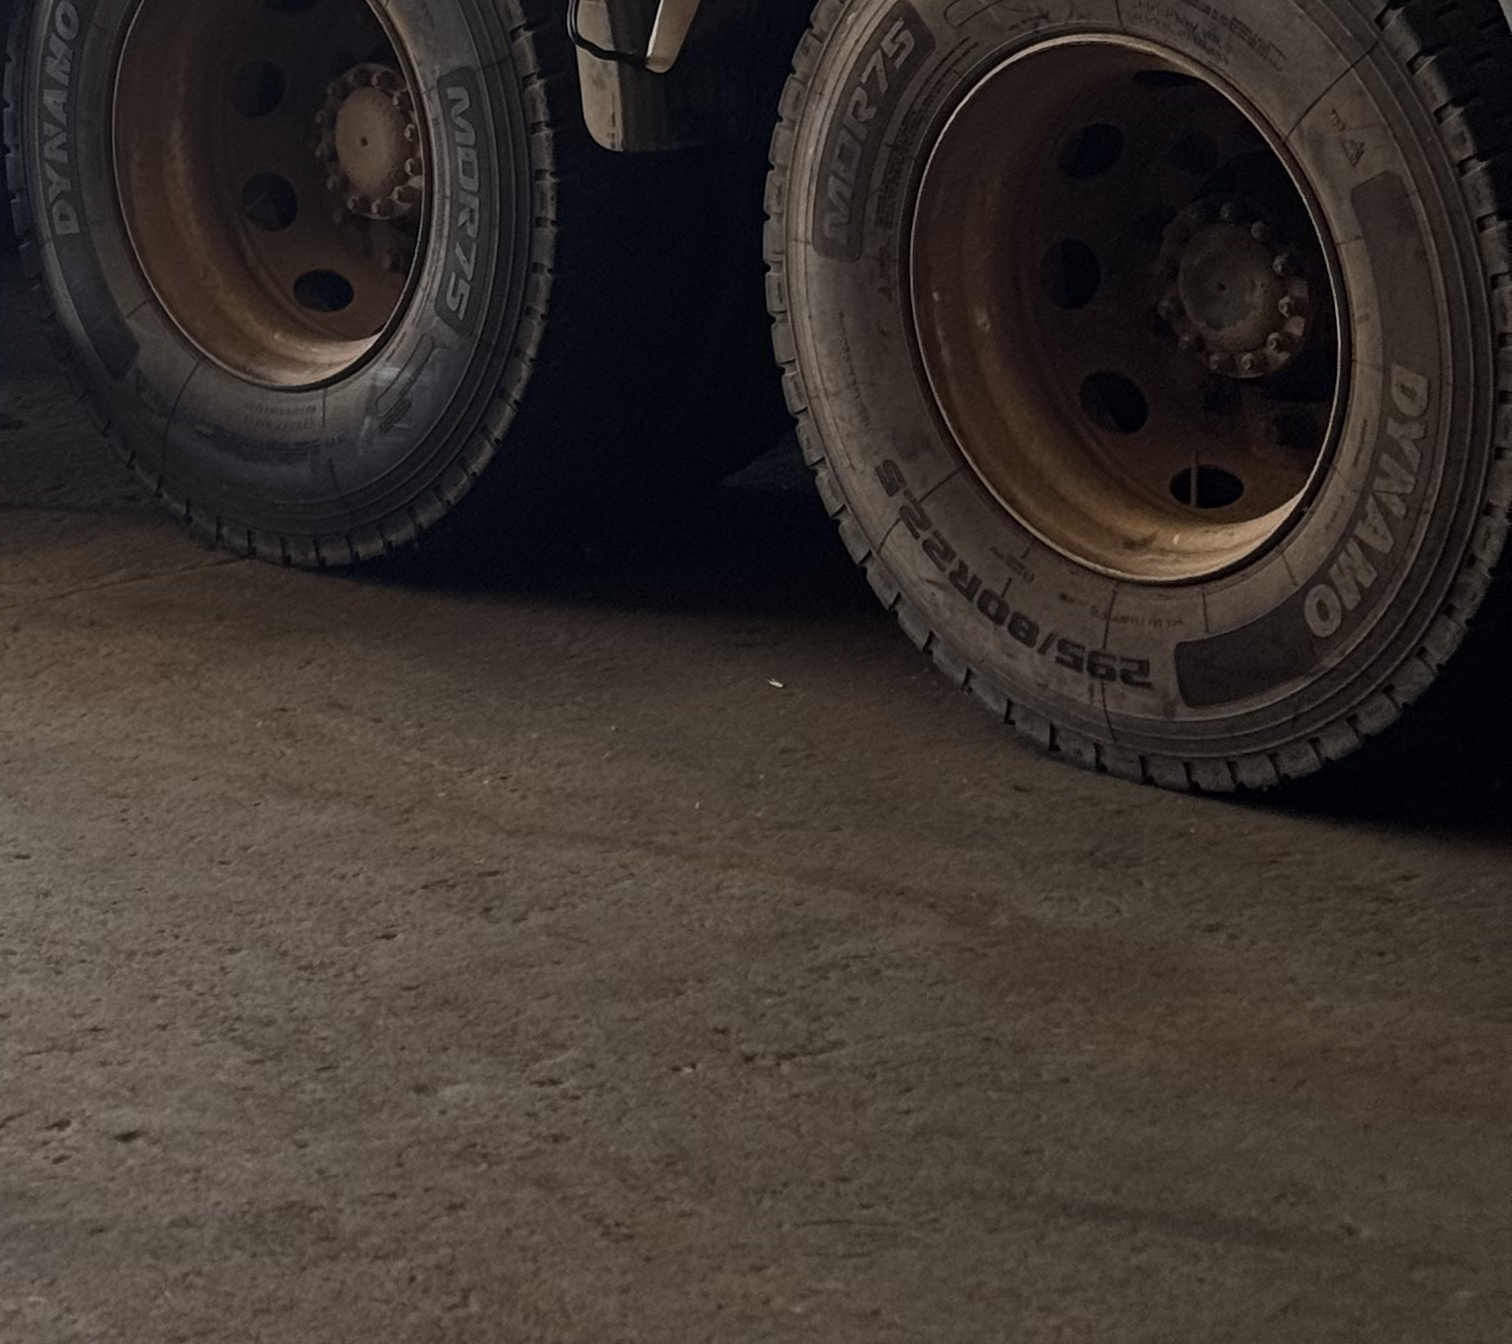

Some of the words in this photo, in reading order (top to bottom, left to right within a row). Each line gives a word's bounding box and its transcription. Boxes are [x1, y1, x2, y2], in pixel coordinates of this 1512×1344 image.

[445, 85, 481, 322] MDR75
[822, 16, 916, 245] MDR75
[874, 459, 1153, 692] 295/80R22.5
[1303, 362, 1430, 639] DYNAMO
